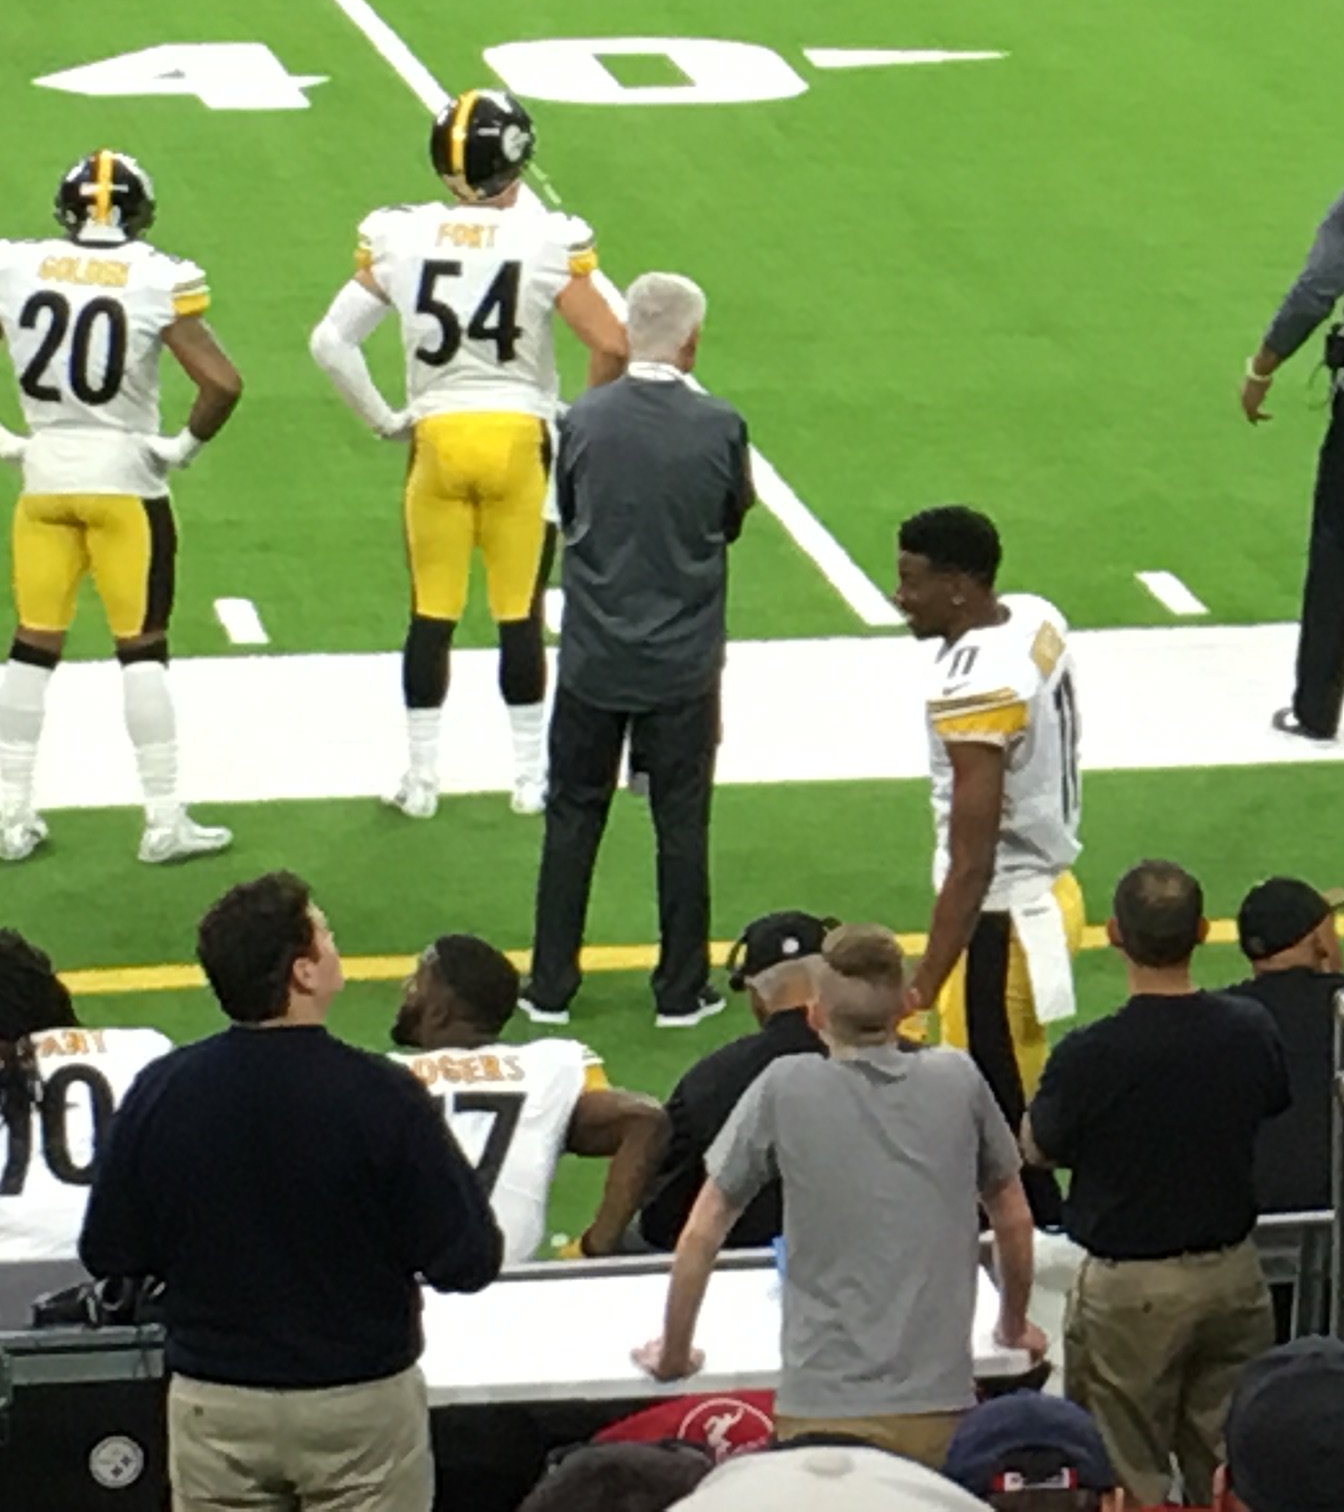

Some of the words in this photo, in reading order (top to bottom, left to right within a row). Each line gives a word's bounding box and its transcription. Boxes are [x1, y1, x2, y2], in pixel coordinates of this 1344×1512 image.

[19, 289, 127, 406] 20
[415, 258, 523, 368] 54
[411, 1054, 526, 1085] OGERS
